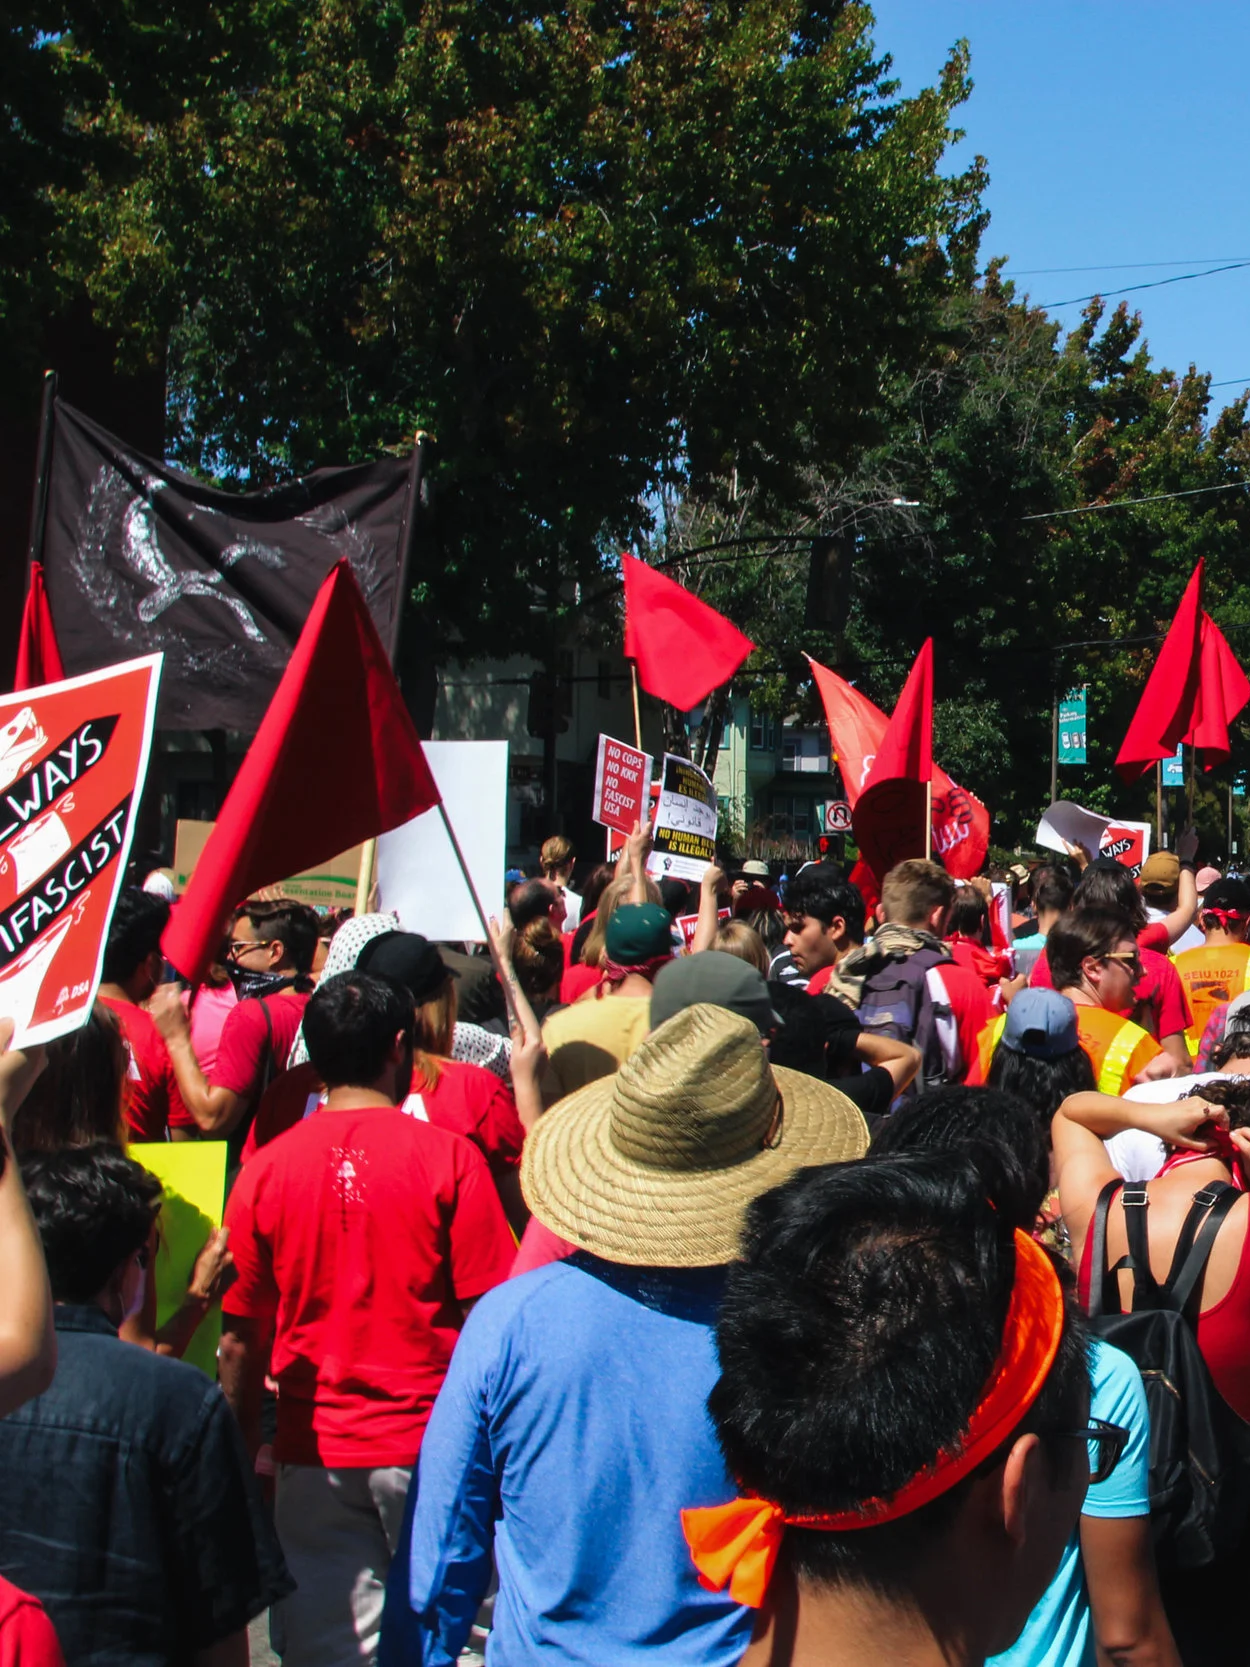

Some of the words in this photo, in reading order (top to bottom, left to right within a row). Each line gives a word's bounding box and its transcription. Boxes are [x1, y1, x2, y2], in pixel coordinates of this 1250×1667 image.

[608, 745, 621, 758] NO
[622, 752, 644, 769] COPS
[606, 760, 620, 774] NO
[620, 766, 639, 783] KKK
[0, 724, 103, 842] WAYS
[605, 775, 618, 789] NO
[604, 789, 636, 810] FASCIST
[604, 801, 621, 817] USA
[658, 828, 671, 839] NO
[672, 829, 700, 845] HUMAN
[668, 841, 677, 851] IS
[678, 842, 712, 859] ILLEGAL!
[1102, 838, 1131, 858] WAYS
[283, 886, 333, 898] esentation
[335, 889, 356, 899] Boar
[1184, 970, 1211, 980] SEIU
[1215, 969, 1239, 979] 1021
[71, 980, 90, 999] DSA
